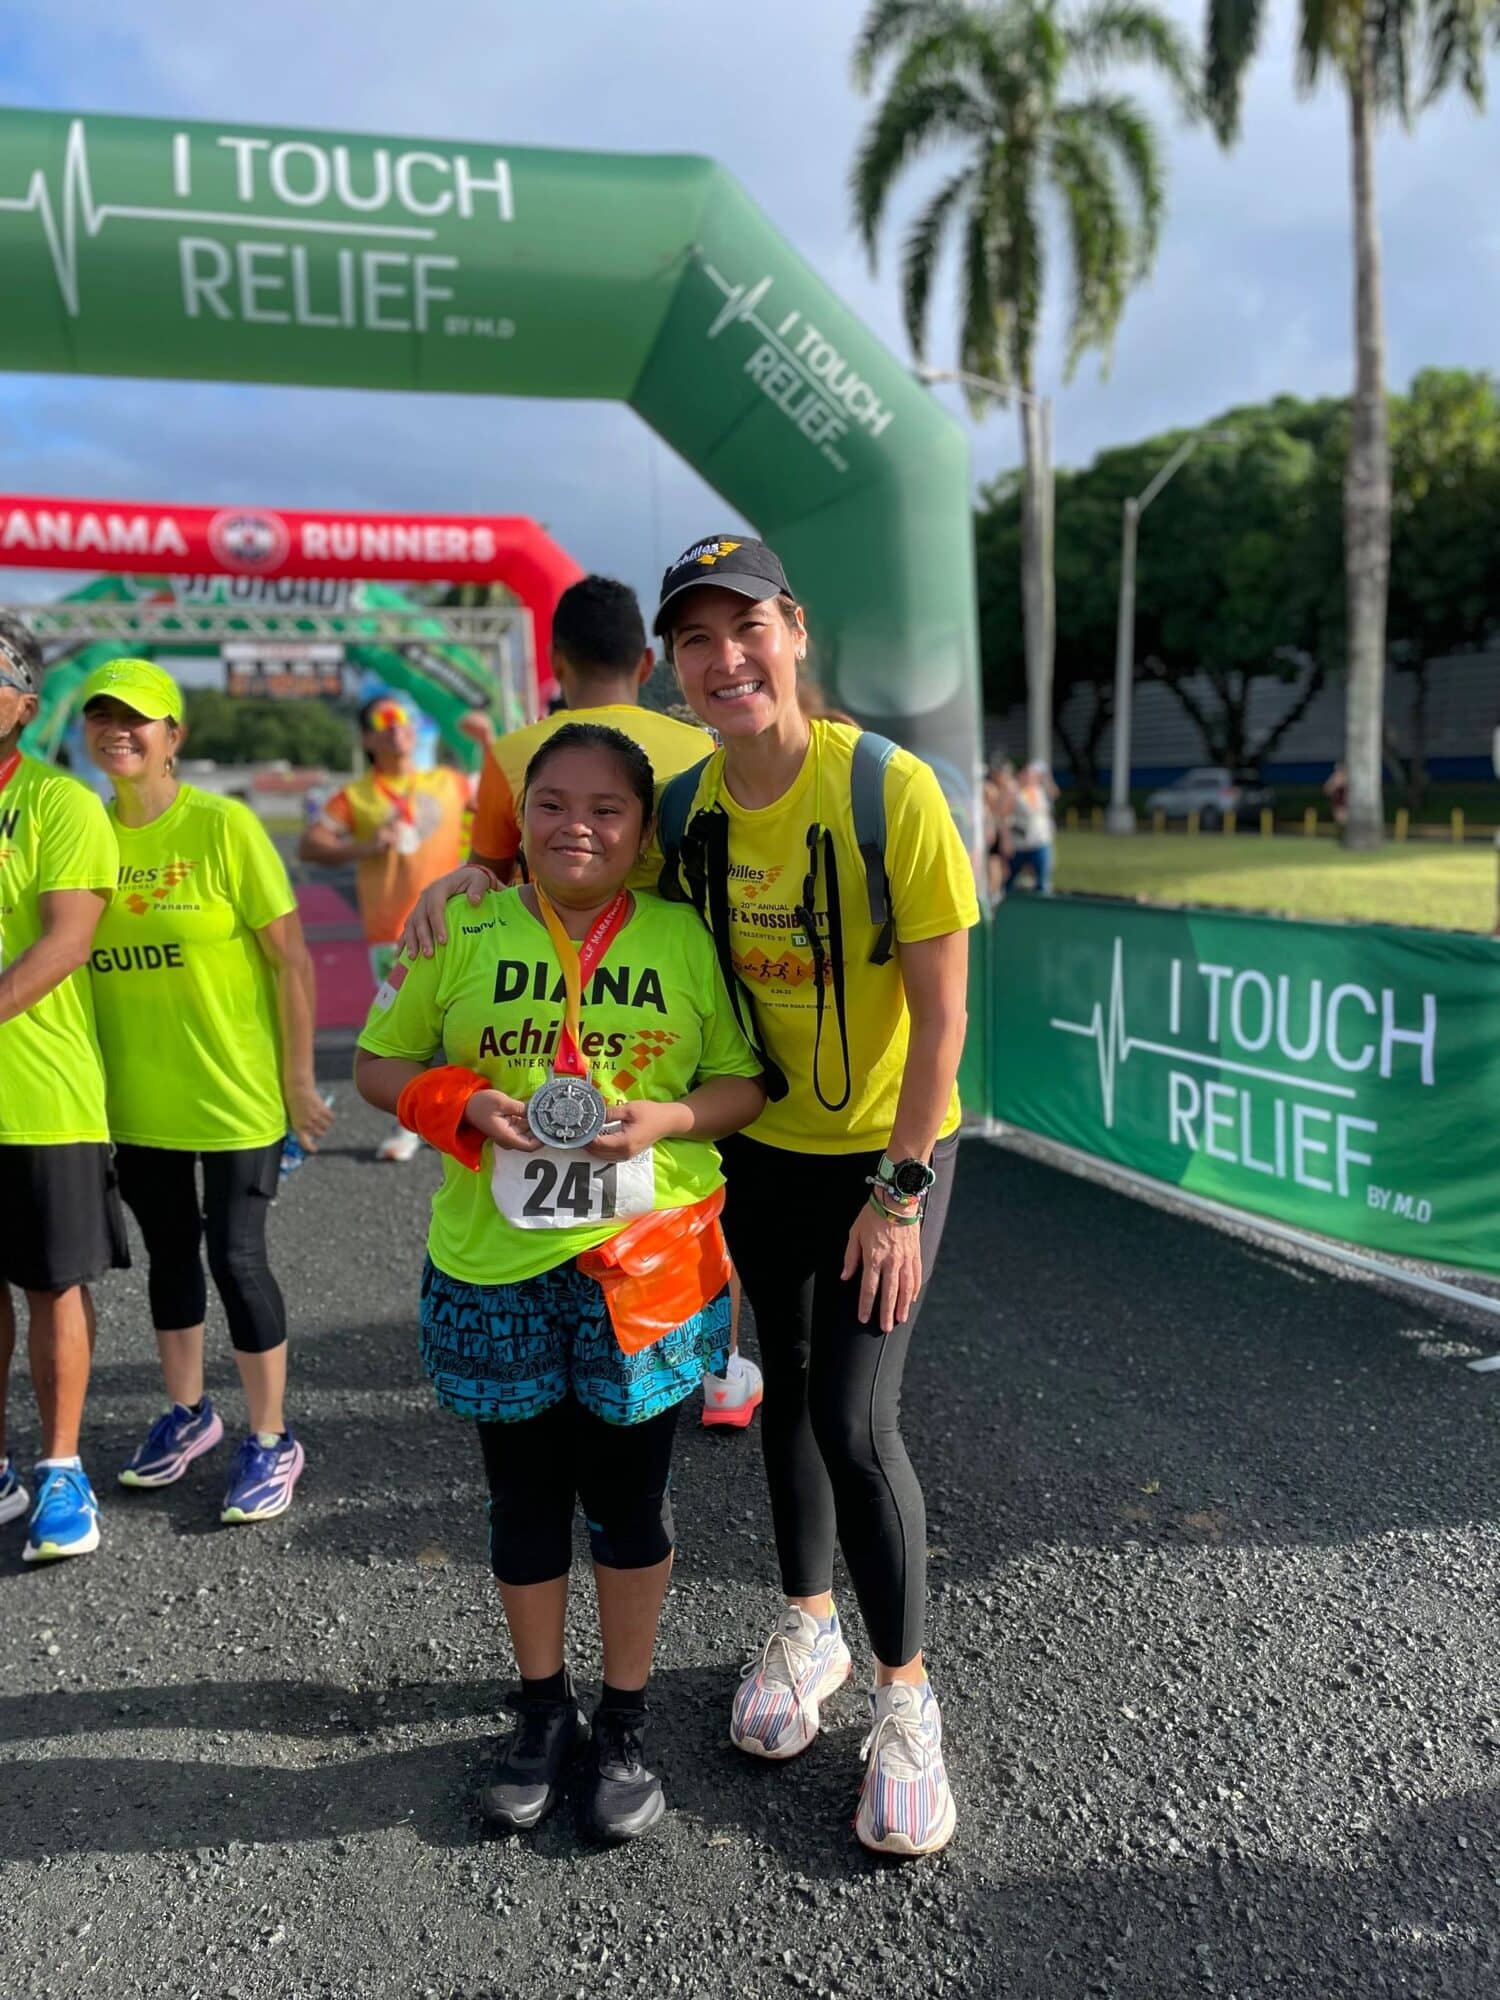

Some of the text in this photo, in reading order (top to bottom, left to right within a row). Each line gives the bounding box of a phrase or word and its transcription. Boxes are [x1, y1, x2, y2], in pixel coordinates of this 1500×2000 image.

[173, 132, 515, 221] I TOUCH
[179, 236, 459, 332] RELIEF
[743, 345, 849, 444] RELIEF
[777, 310, 895, 437] I TOUCH
[0, 508, 497, 562] ANAMA RUNNERS
[118, 866, 158, 884] lles
[728, 864, 765, 881] hilles
[154, 903, 200, 911] Panama
[758, 904, 790, 912] ANNUAL
[92, 943, 184, 974] GUIDE
[479, 1018, 627, 1059] Achies
[1170, 958, 1436, 1086] I TOUCH
[508, 1058, 617, 1070] INTERNNAL
[1169, 1070, 1378, 1198] RELIEF
[1367, 1184, 1394, 1210] BY
[522, 1158, 619, 1219] 241
